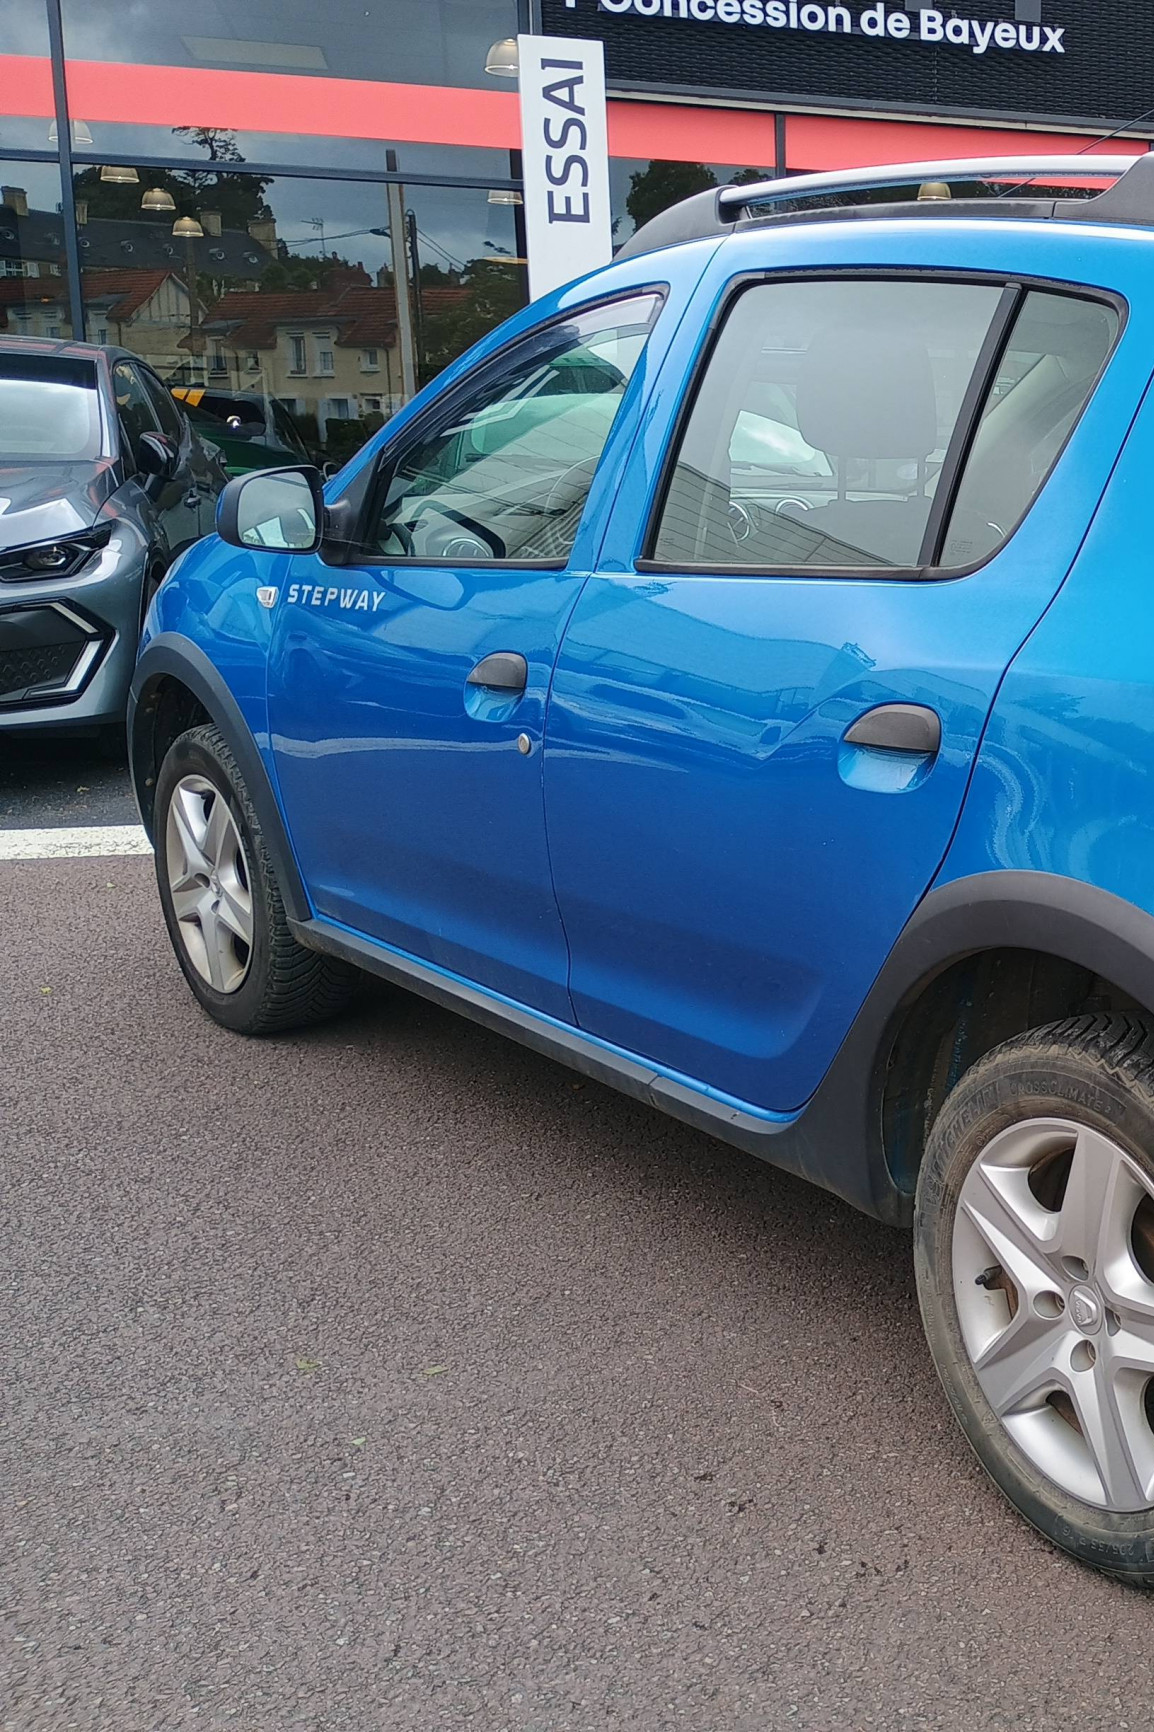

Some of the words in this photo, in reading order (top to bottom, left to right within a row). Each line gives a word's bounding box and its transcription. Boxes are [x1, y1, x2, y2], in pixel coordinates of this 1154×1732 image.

[860, 6, 911, 40] de
[919, 10, 1066, 55] Bayeux
[540, 57, 591, 225] ESSAI
[287, 583, 386, 612] STEPWAY
